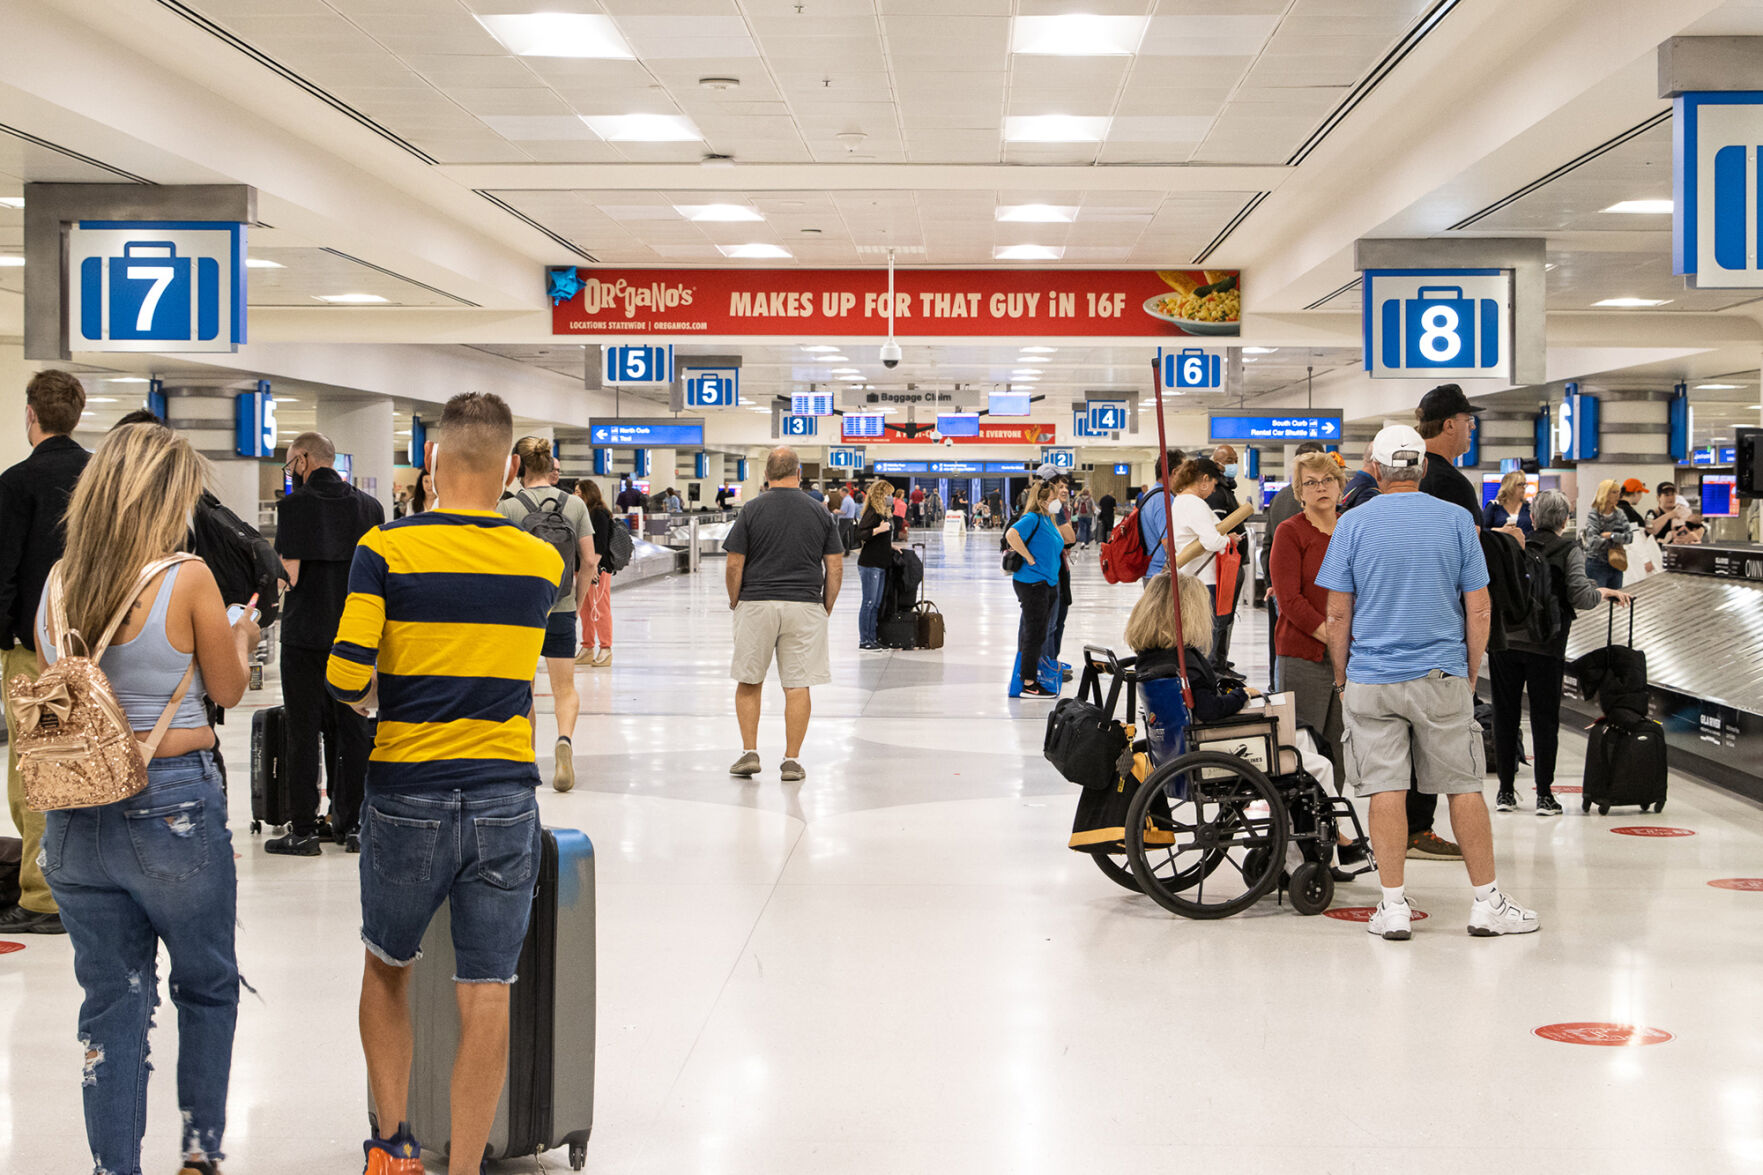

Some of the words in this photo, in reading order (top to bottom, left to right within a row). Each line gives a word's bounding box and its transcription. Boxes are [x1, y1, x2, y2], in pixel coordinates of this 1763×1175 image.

[126, 266, 175, 331] 7
[729, 291, 814, 317] MAKES
[822, 292, 856, 317] UP
[864, 292, 912, 318] FOR
[920, 293, 981, 318] THAT
[990, 292, 1040, 318] GUY
[1087, 293, 1126, 318] 16F
[654, 322, 708, 330] OREGANOS.COM
[1419, 305, 1462, 362] 8
[626, 350, 646, 378] 5
[1183, 357, 1203, 385] 6
[702, 380, 718, 404] 5
[881, 392, 923, 403] Baggage
[263, 400, 278, 450] 5
[792, 418, 804, 434] 3
[1102, 410, 1115, 427] 4
[1558, 402, 1572, 453] 6
[986, 430, 1021, 438] EVERYONE
[838, 453, 845, 465] 1
[1057, 454, 1067, 466] 2
